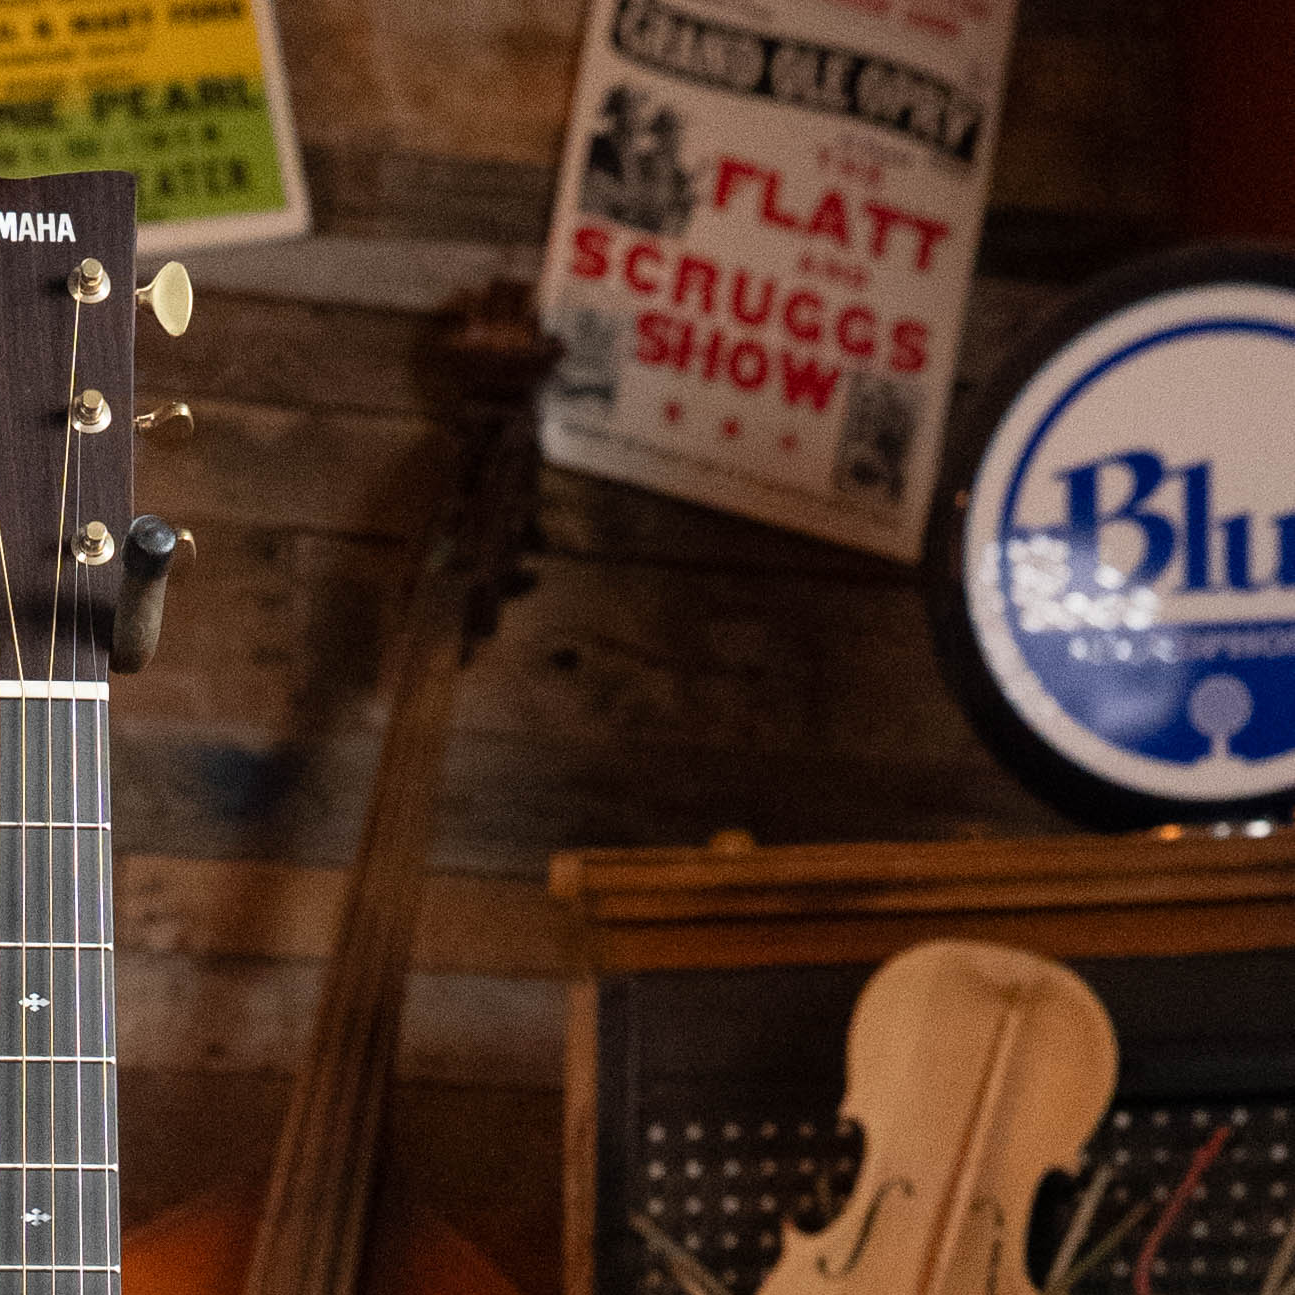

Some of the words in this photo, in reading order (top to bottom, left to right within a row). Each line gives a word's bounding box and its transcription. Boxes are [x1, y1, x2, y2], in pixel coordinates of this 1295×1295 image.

[90, 74, 262, 124] PEARL
[619, 4, 765, 91] GRAND
[771, 46, 847, 110] OLE
[858, 60, 984, 155] OPRY
[711, 156, 952, 274] FLATT
[571, 225, 930, 374] SCRUGGS
[635, 309, 841, 415] SHOW
